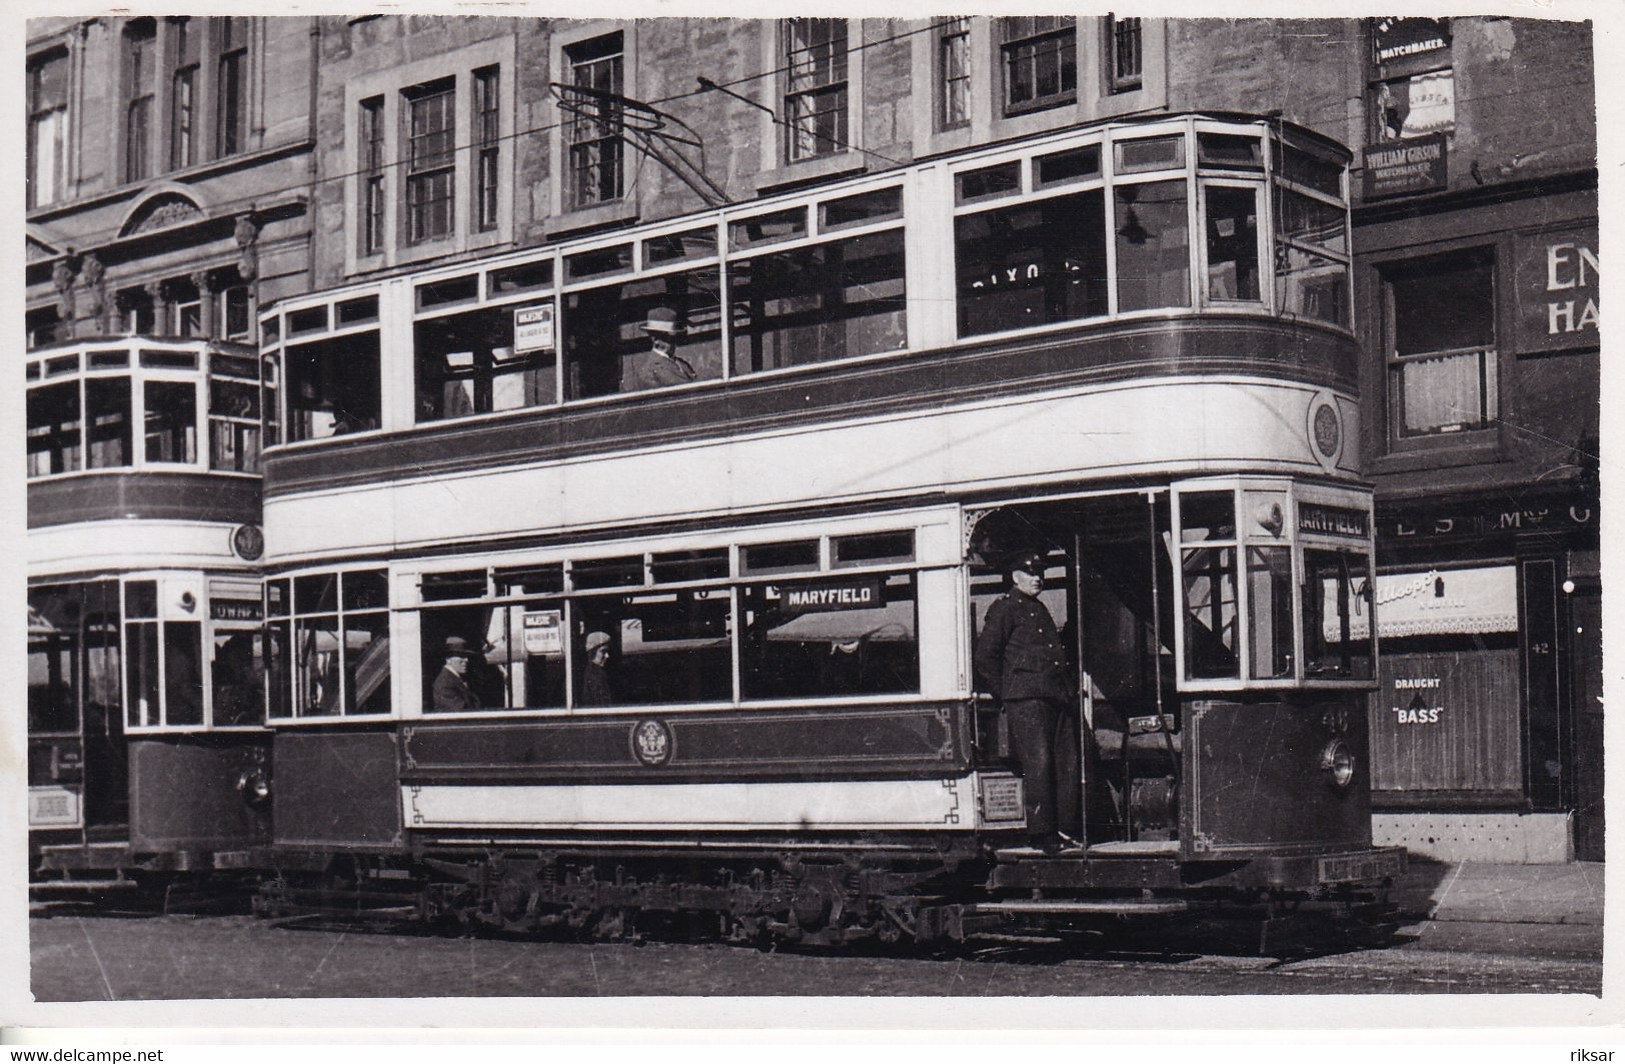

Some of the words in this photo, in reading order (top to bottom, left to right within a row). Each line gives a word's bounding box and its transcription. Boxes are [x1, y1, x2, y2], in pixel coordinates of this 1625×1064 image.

[1380, 38, 1447, 60] WATCHMAKER.
[1366, 148, 1406, 170] WILLIAM
[1375, 161, 1431, 180] WATCHMAKER
[789, 587, 871, 605] MARYFIELD
[1395, 678, 1440, 689] DRAUGHT
[1392, 707, 1443, 723] "BASS"
